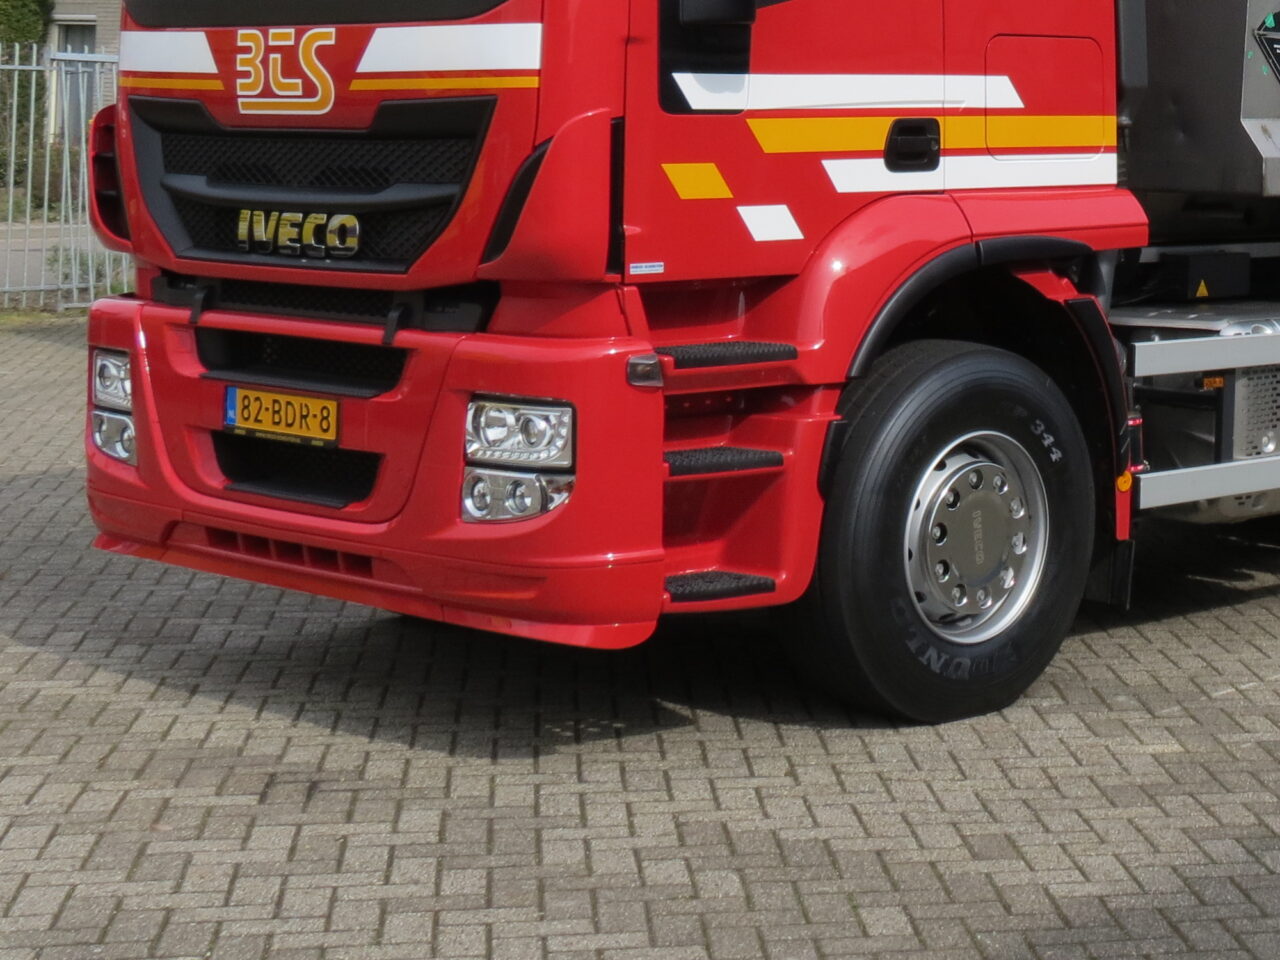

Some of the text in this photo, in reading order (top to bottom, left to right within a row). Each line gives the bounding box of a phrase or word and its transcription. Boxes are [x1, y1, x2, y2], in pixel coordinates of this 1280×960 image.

[238, 209, 359, 257] IVECO
[240, 394, 331, 433] 82-BDR-8
[1030, 419, 1063, 462] 344
